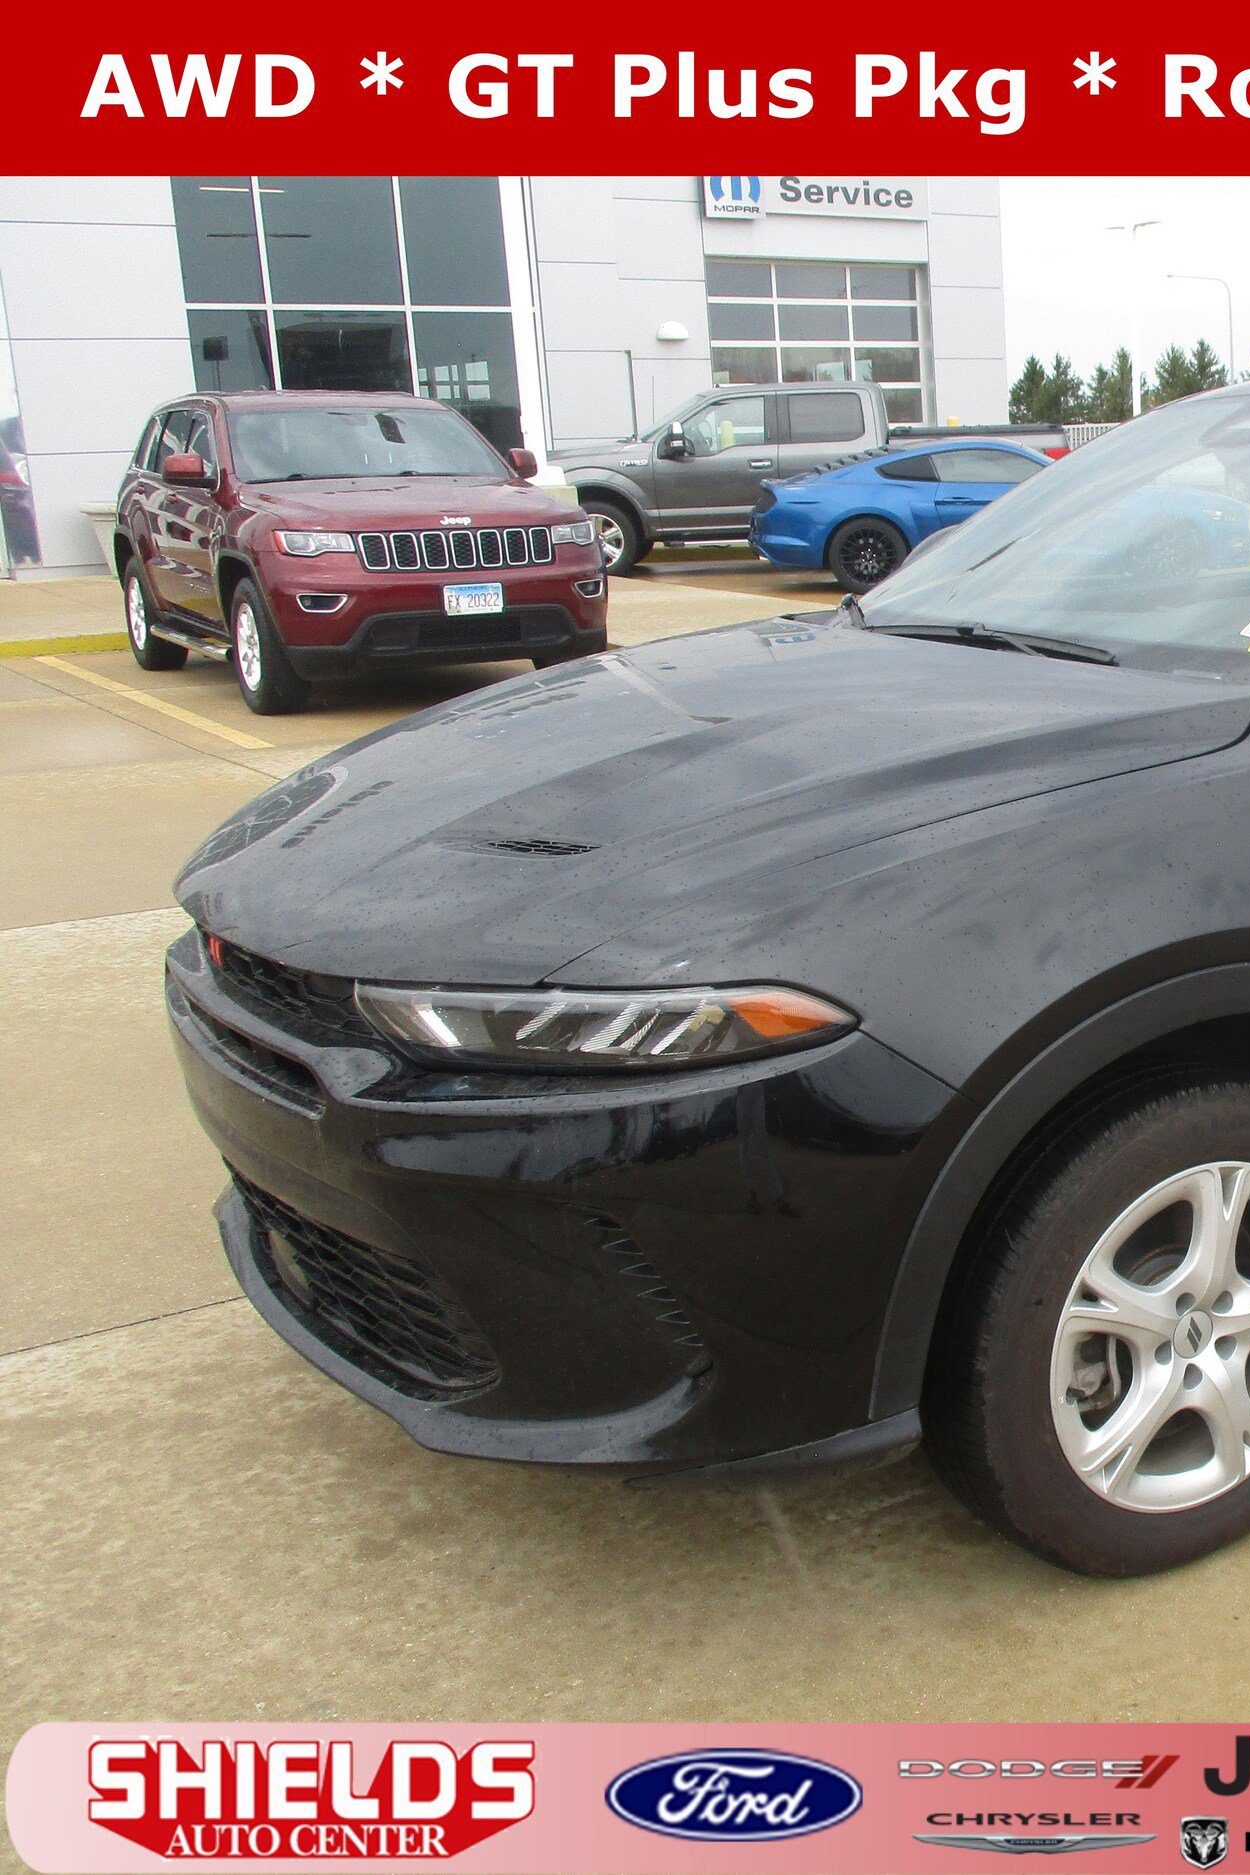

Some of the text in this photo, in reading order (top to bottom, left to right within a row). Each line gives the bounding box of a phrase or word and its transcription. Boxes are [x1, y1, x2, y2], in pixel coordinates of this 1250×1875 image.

[779, 175, 914, 208] Service
[713, 204, 760, 214] MOPAR
[440, 516, 471, 526] Jeep
[467, 592, 500, 608] 20322
